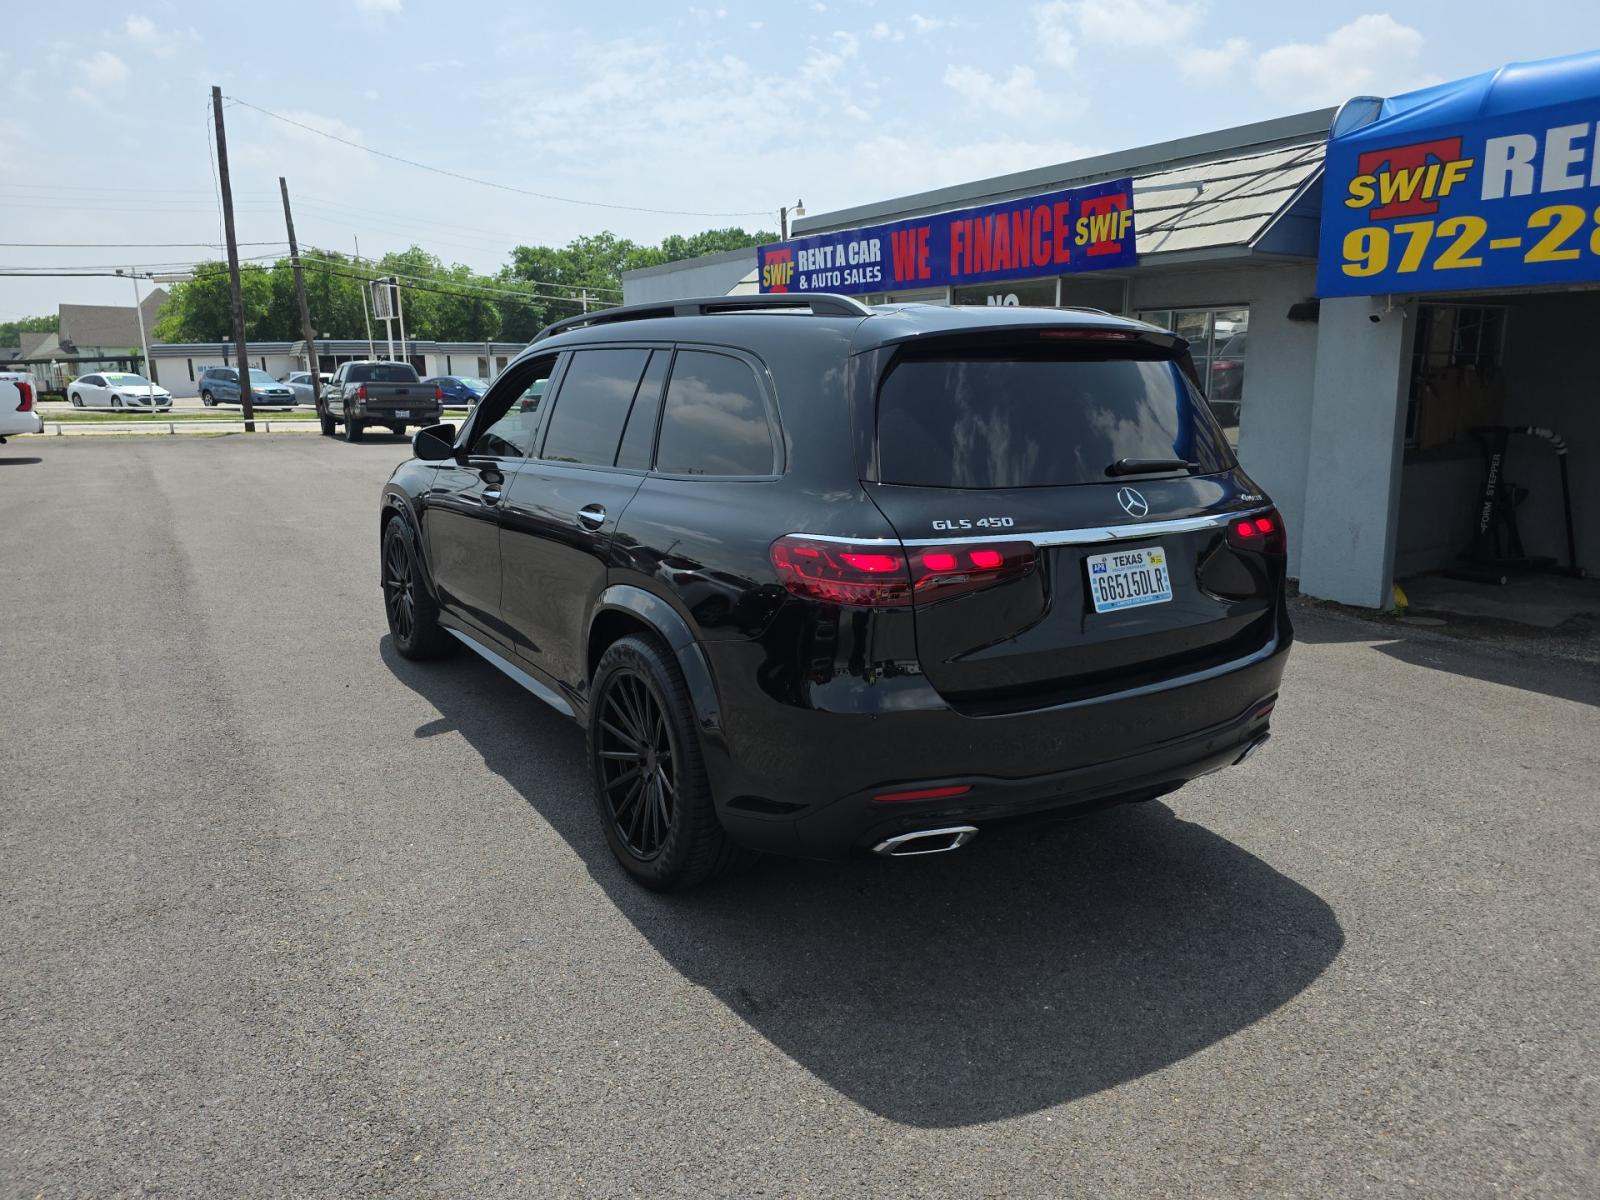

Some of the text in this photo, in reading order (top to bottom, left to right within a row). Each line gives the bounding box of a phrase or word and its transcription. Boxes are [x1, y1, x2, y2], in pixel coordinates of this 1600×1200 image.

[1481, 121, 1600, 201] RE
[798, 239, 881, 272] RENT A CAR
[891, 202, 1071, 282] WE FINANCE
[1341, 204, 1600, 278] 972-2
[800, 266, 882, 290] & AUTO SALES
[932, 517, 1014, 530] GLS 450
[1112, 554, 1143, 567] TEXAS
